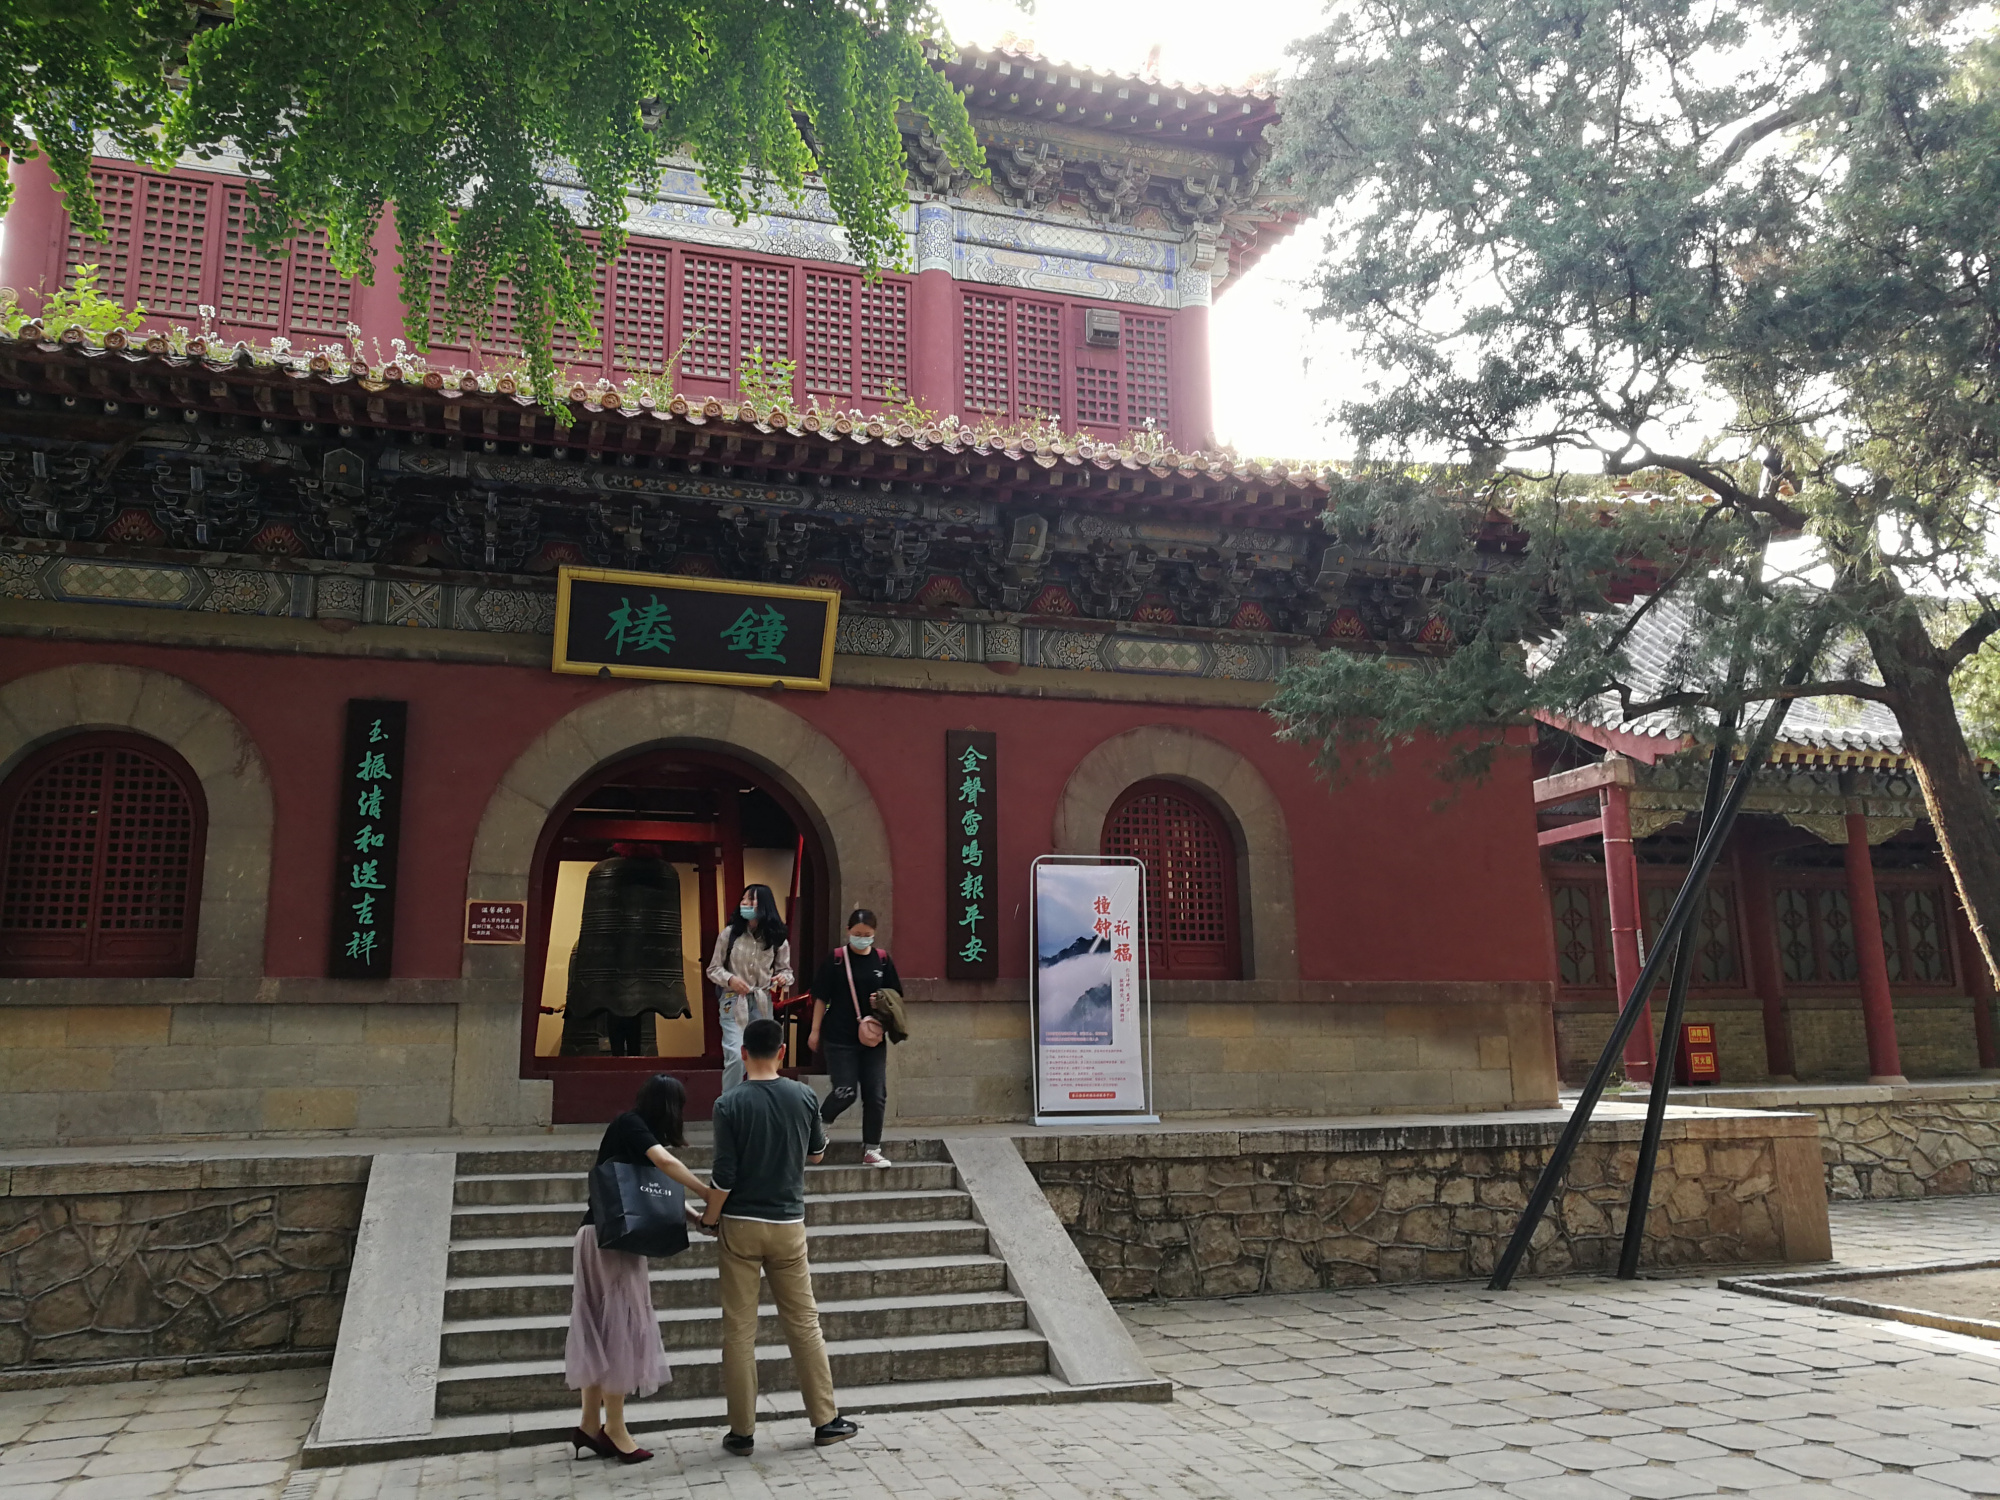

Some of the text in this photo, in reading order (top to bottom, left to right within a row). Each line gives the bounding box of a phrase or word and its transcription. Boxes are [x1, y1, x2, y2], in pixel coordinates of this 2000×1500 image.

[1093, 896, 1112, 939] 撞钟
[1113, 919, 1133, 963] 祈福
[639, 1185, 672, 1197] COACH
